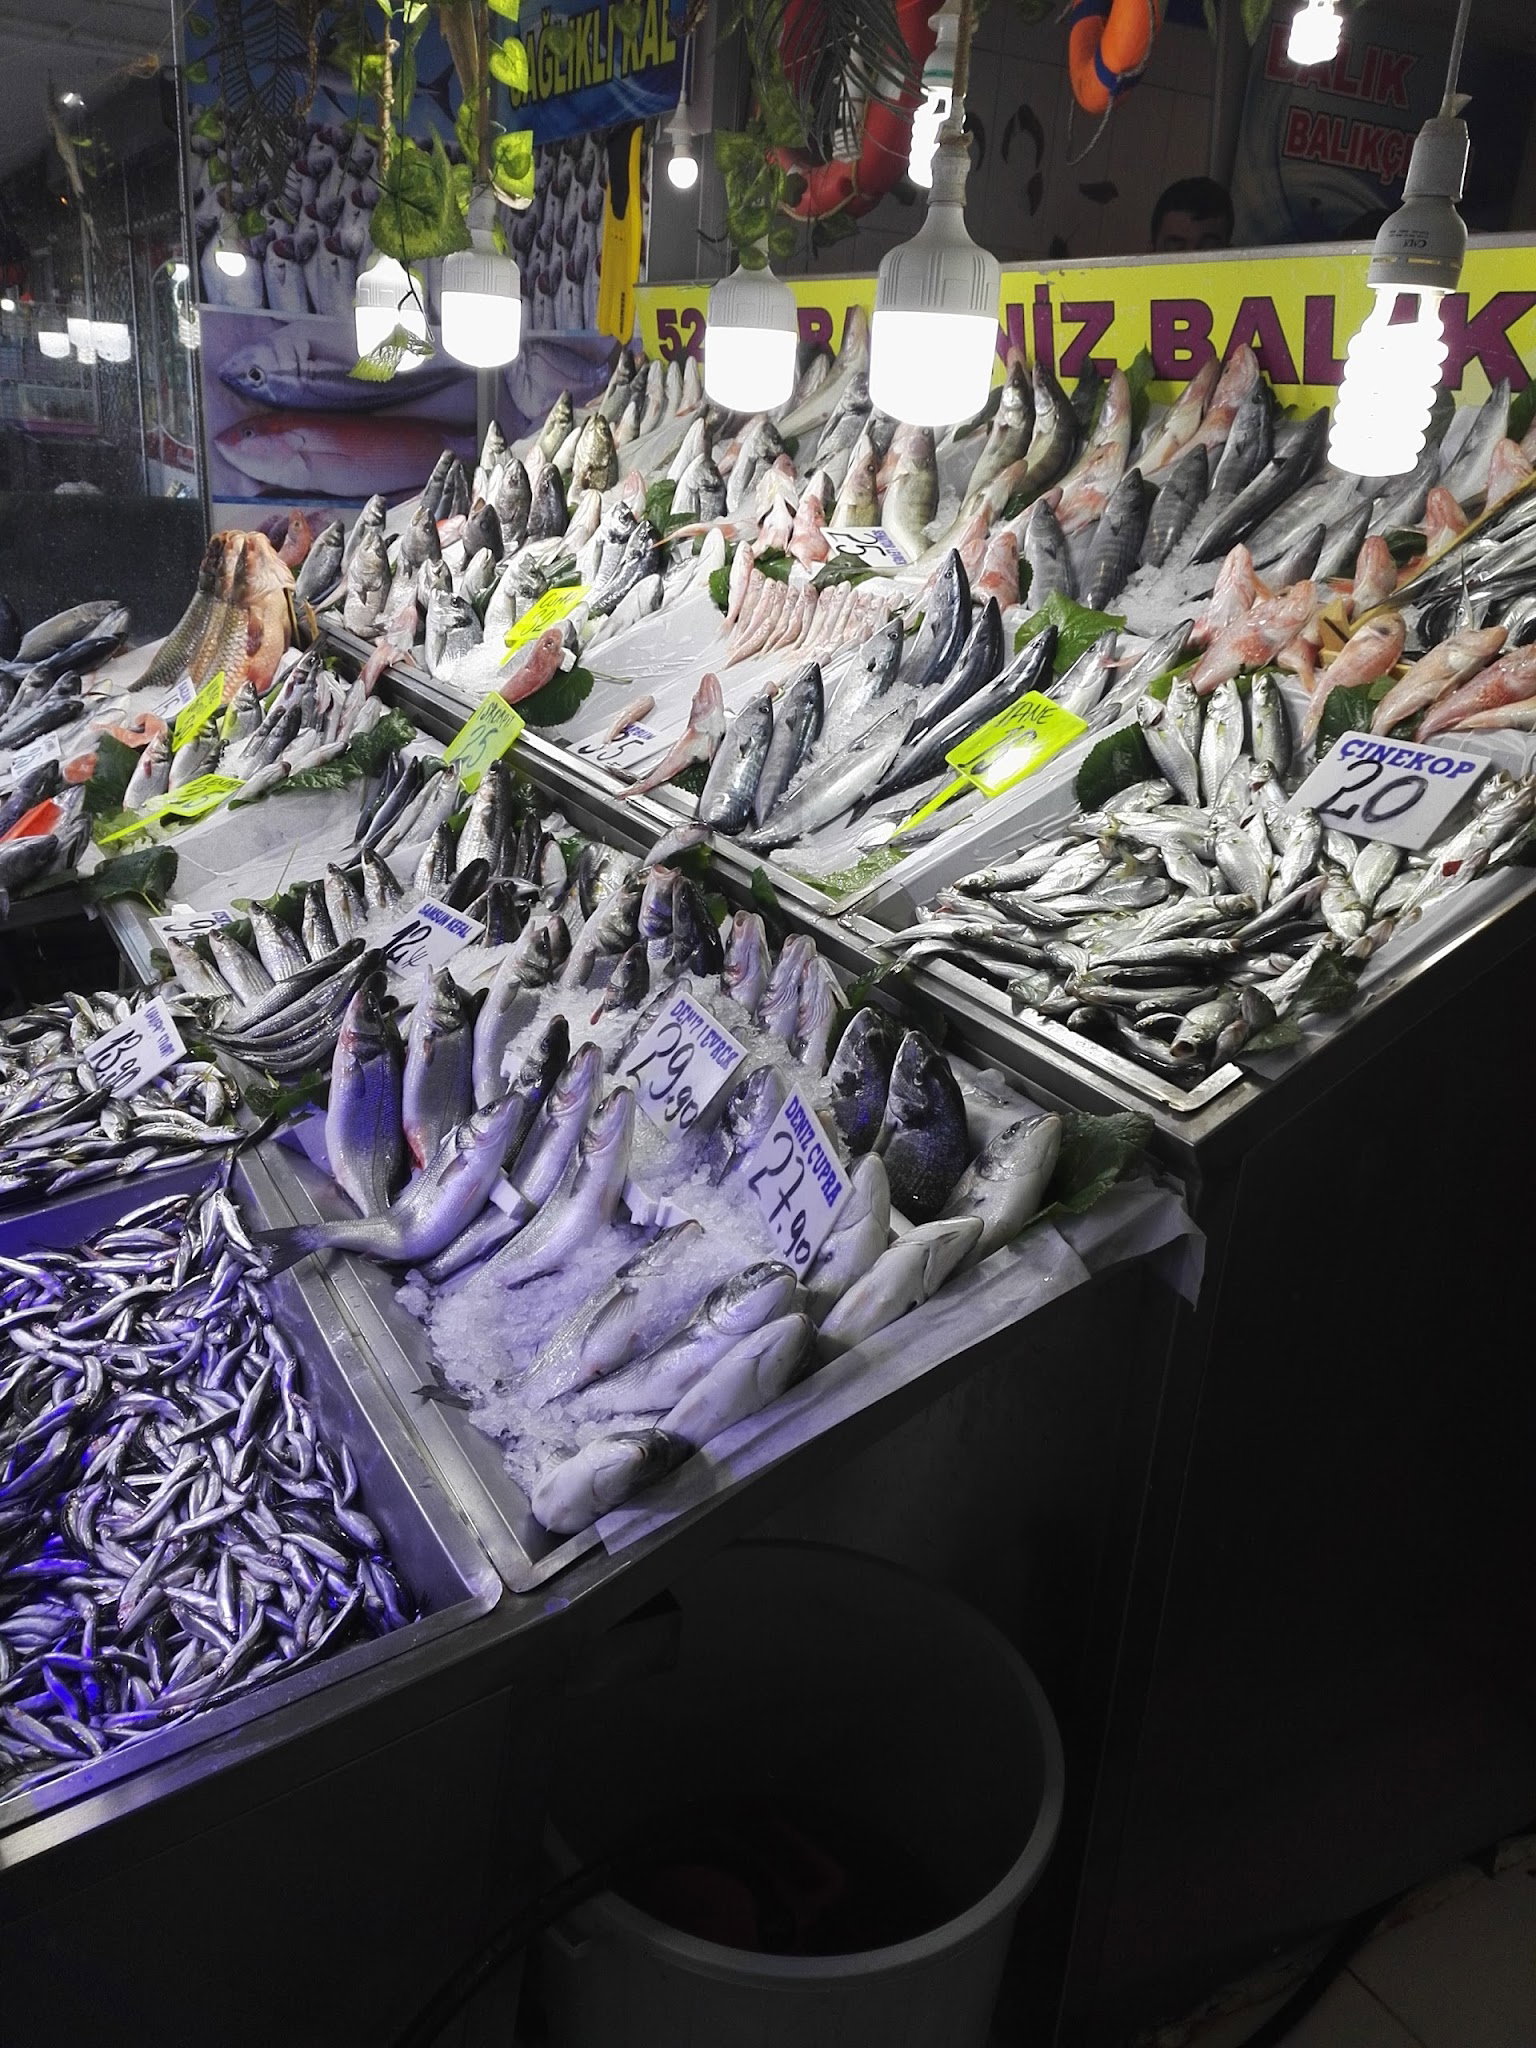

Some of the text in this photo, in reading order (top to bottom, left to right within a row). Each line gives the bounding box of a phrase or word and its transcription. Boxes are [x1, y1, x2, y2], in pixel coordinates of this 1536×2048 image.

[510, 4, 615, 109] AĞLIKLI
[1151, 291, 1536, 391] BALK
[826, 531, 887, 555] 25
[1315, 758, 1430, 823] 20
[807, 1143, 844, 1208] CUPRA
